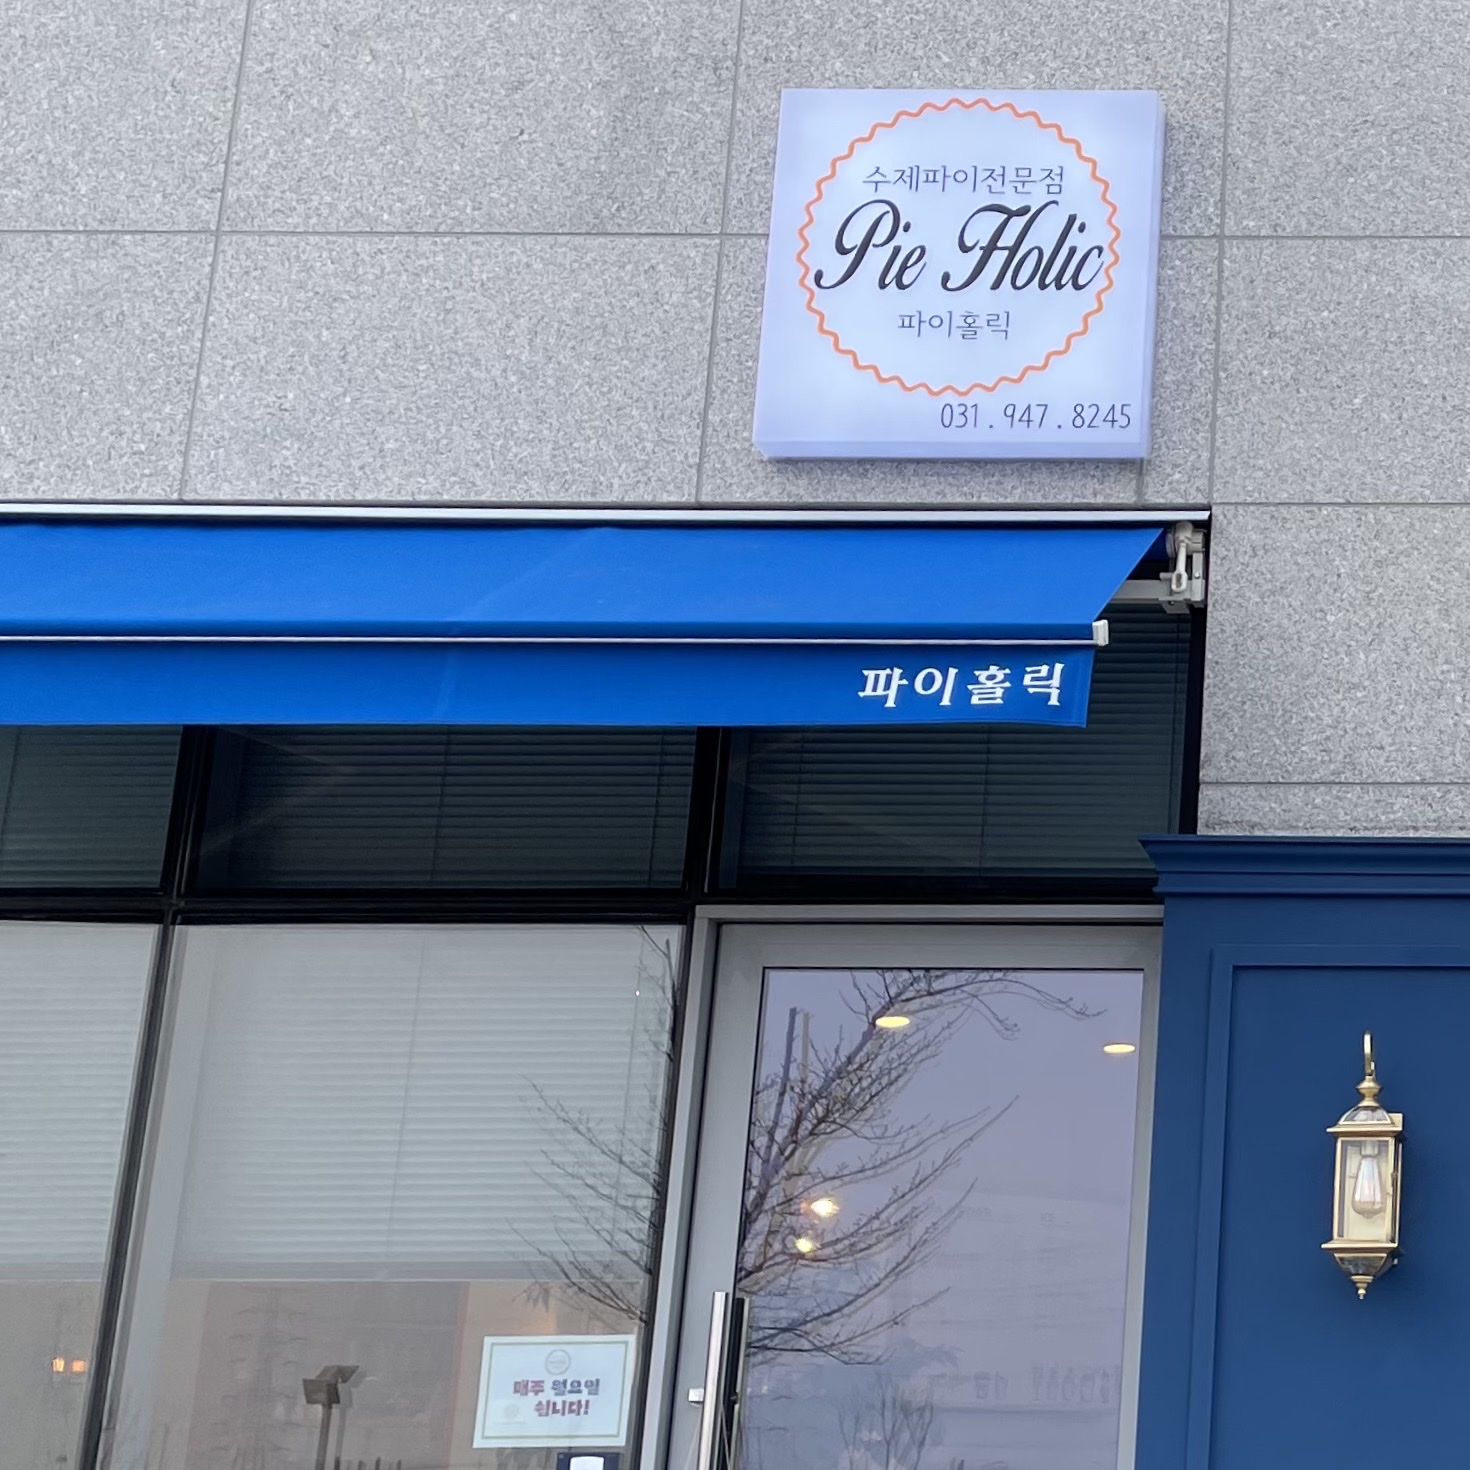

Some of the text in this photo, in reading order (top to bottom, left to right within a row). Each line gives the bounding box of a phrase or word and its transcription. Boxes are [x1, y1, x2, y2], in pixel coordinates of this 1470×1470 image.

[862, 164, 1065, 195] 수제파이전문점
[813, 199, 1104, 292] Pie Holic
[897, 310, 1011, 341] 파이홀릭
[857, 662, 1066, 708] 파이홀릭
[512, 1378, 601, 1397] 매주 월요일
